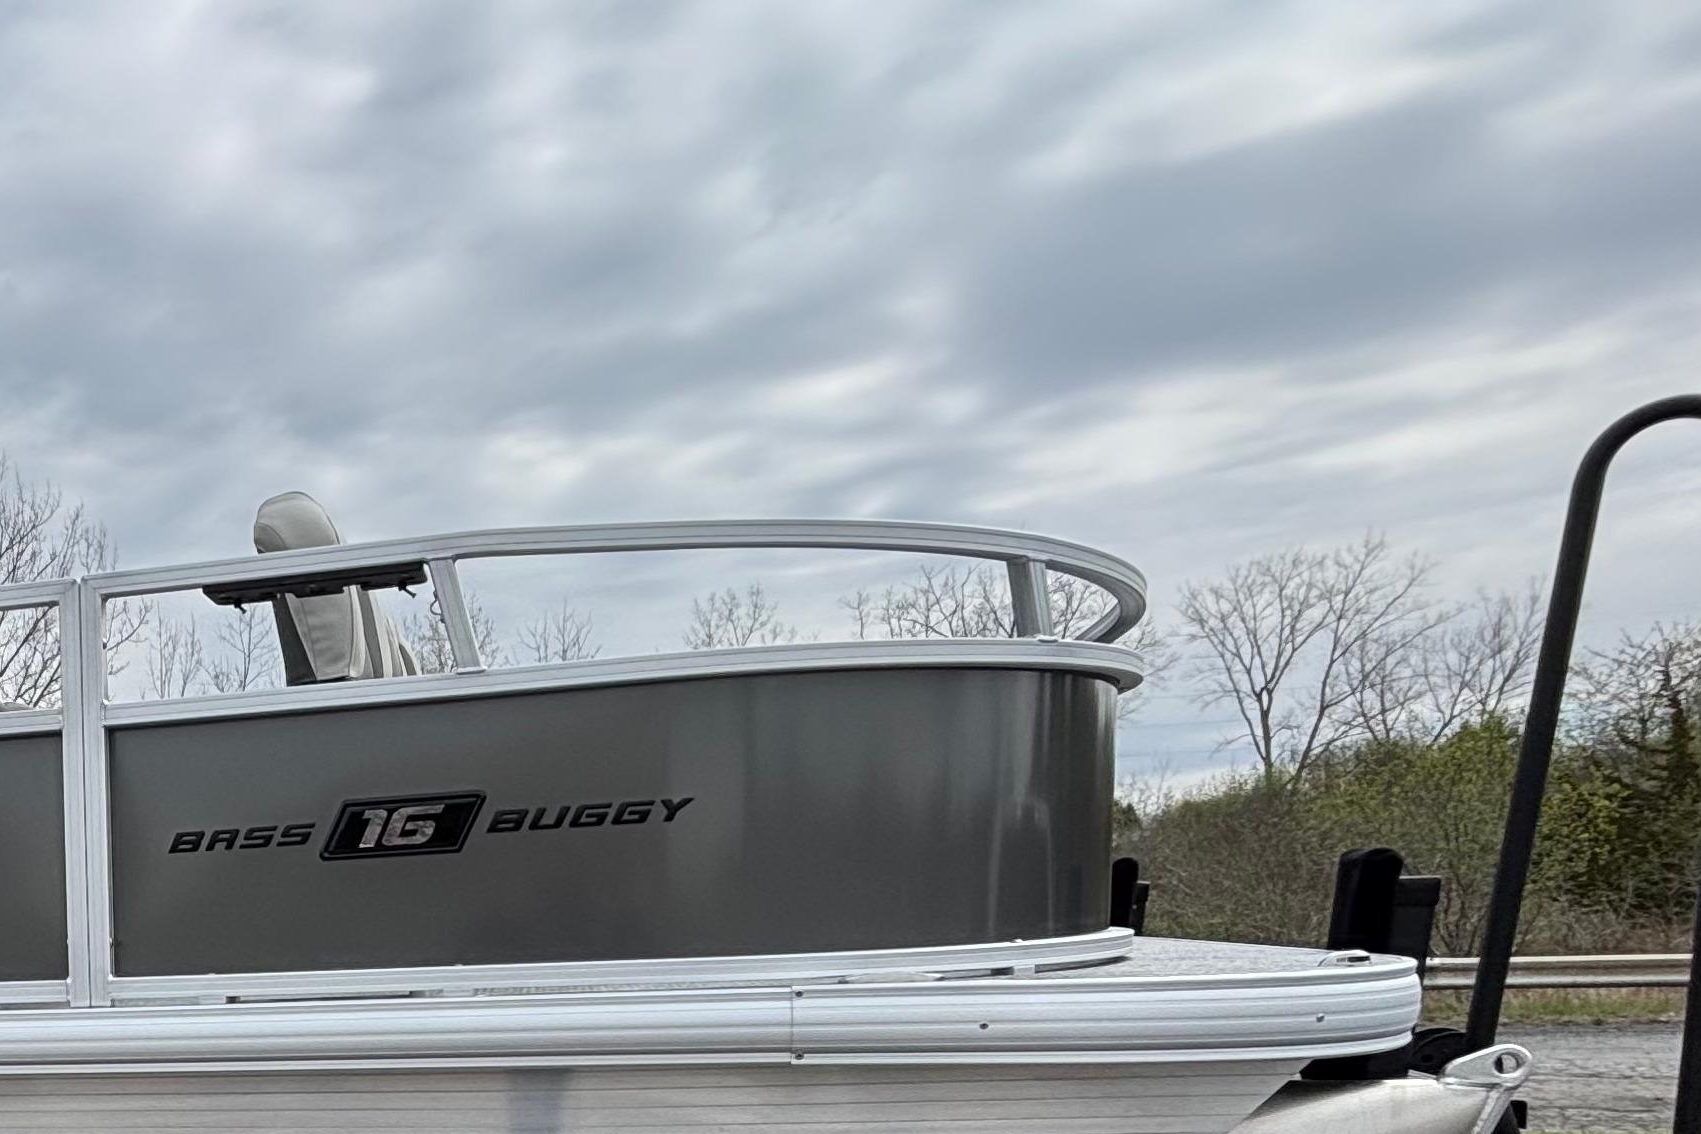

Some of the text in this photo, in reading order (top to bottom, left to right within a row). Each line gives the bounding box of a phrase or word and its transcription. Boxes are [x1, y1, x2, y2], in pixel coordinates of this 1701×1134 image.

[168, 797, 695, 854] BASS 16 BUGGY
